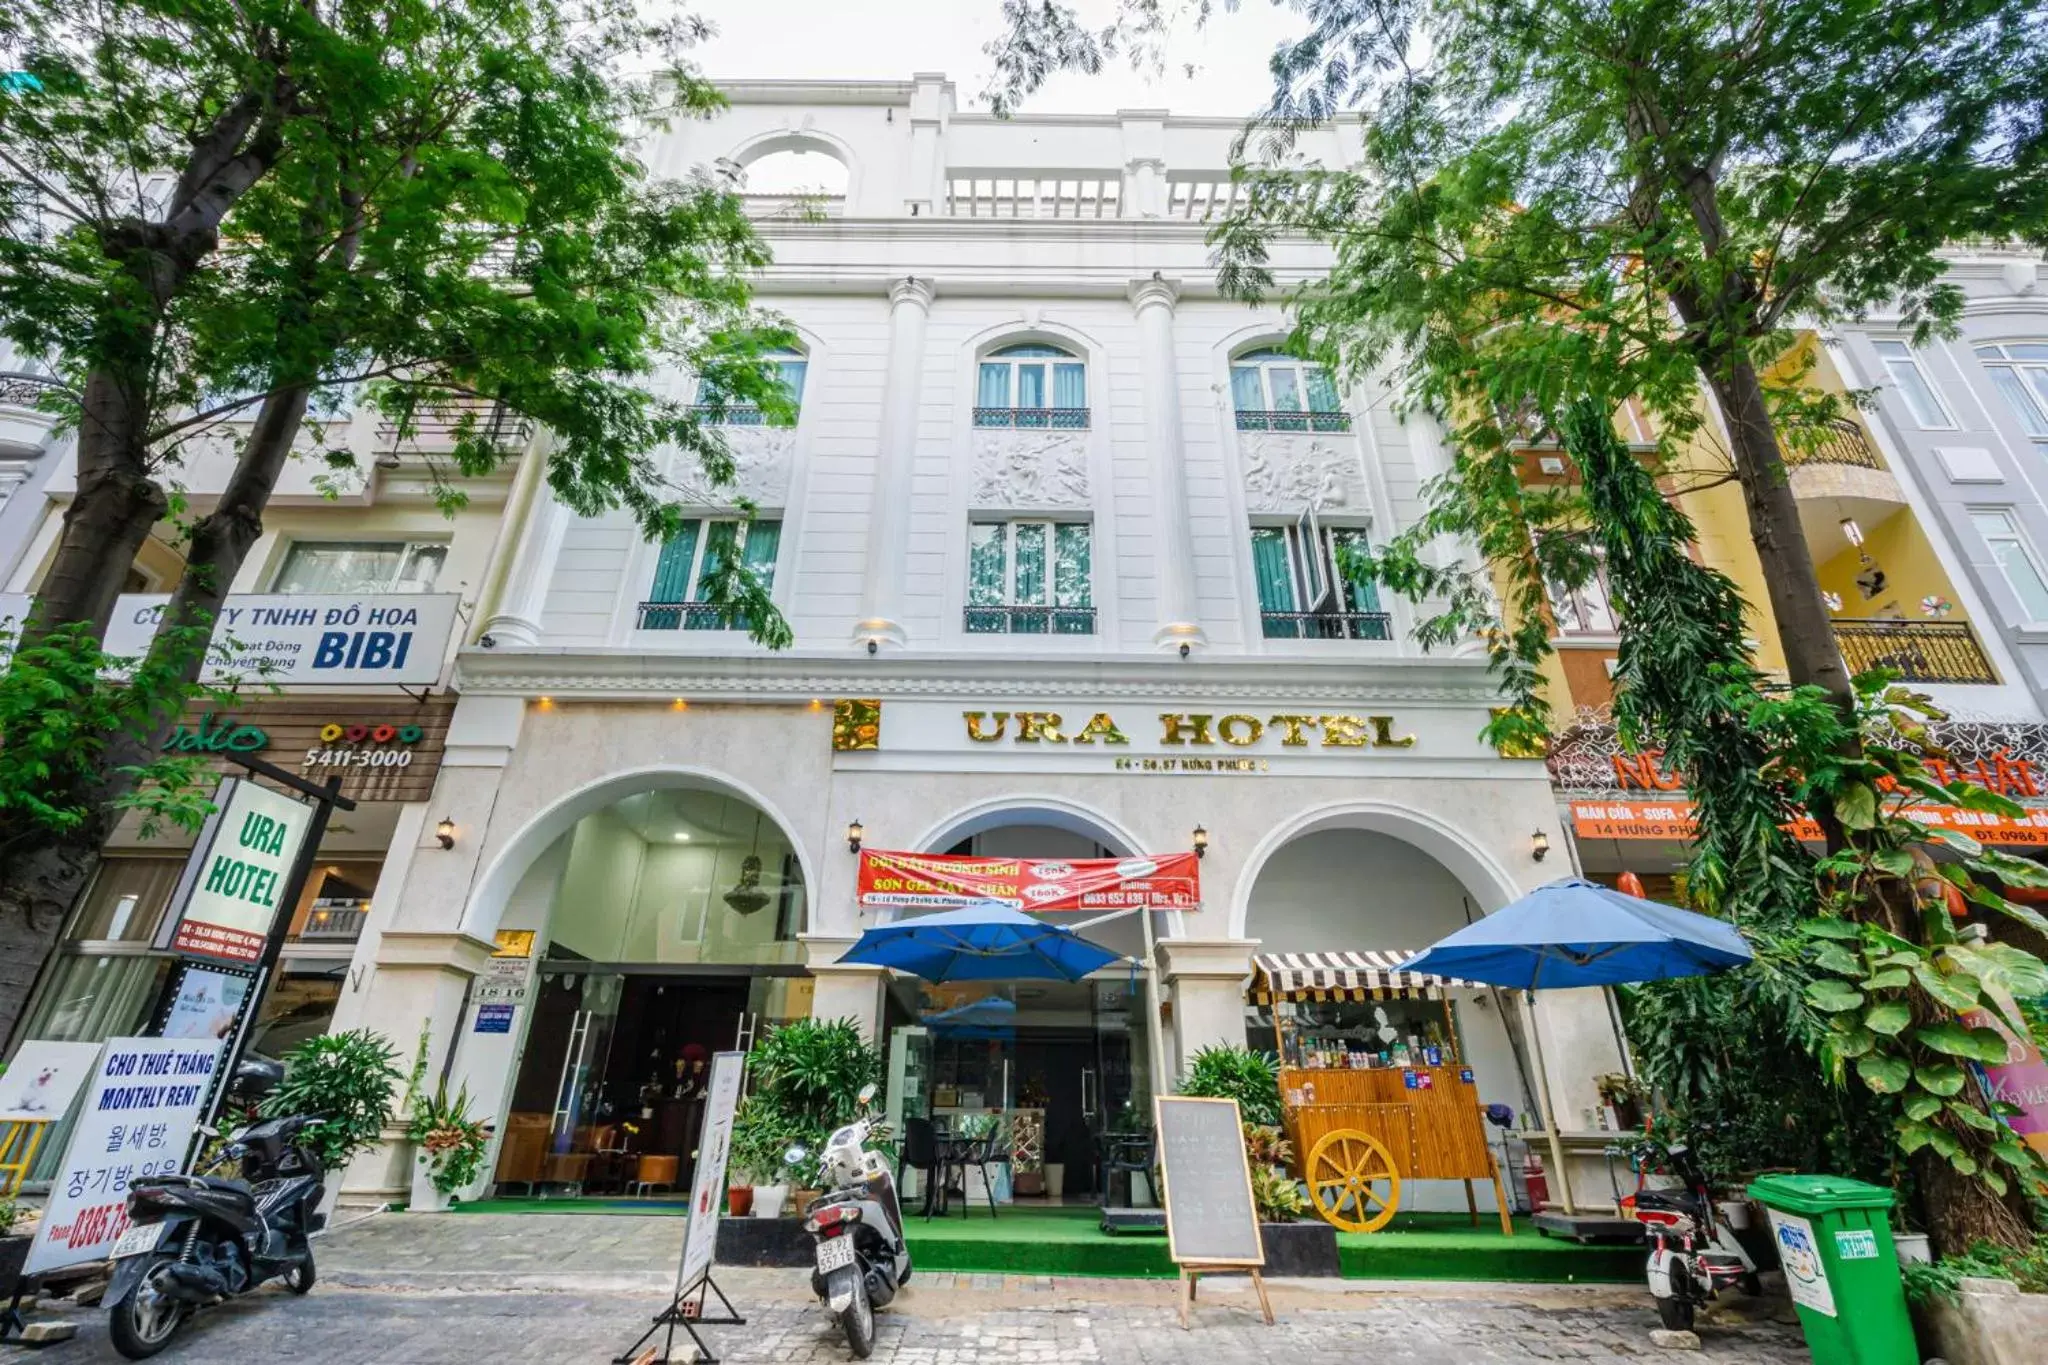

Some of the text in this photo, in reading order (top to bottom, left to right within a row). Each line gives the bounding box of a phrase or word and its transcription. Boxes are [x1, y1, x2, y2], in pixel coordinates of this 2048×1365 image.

[220, 608, 243, 625] Y
[251, 608, 317, 626] TNHH
[312, 631, 413, 669] BIBI
[963, 710, 1418, 748] URA HOTEL
[302, 749, 412, 768] 5411-3000
[1643, 807, 1677, 821] SOFA
[239, 811, 287, 858] URA
[1595, 823, 1612, 835] 14
[2000, 831, 2038, 842] 0986
[204, 855, 279, 907] HOTEL
[105, 1053, 138, 1076] CHO
[98, 1085, 201, 1111] MONTHLY RENT
[68, 1205, 113, 1250] 0385
